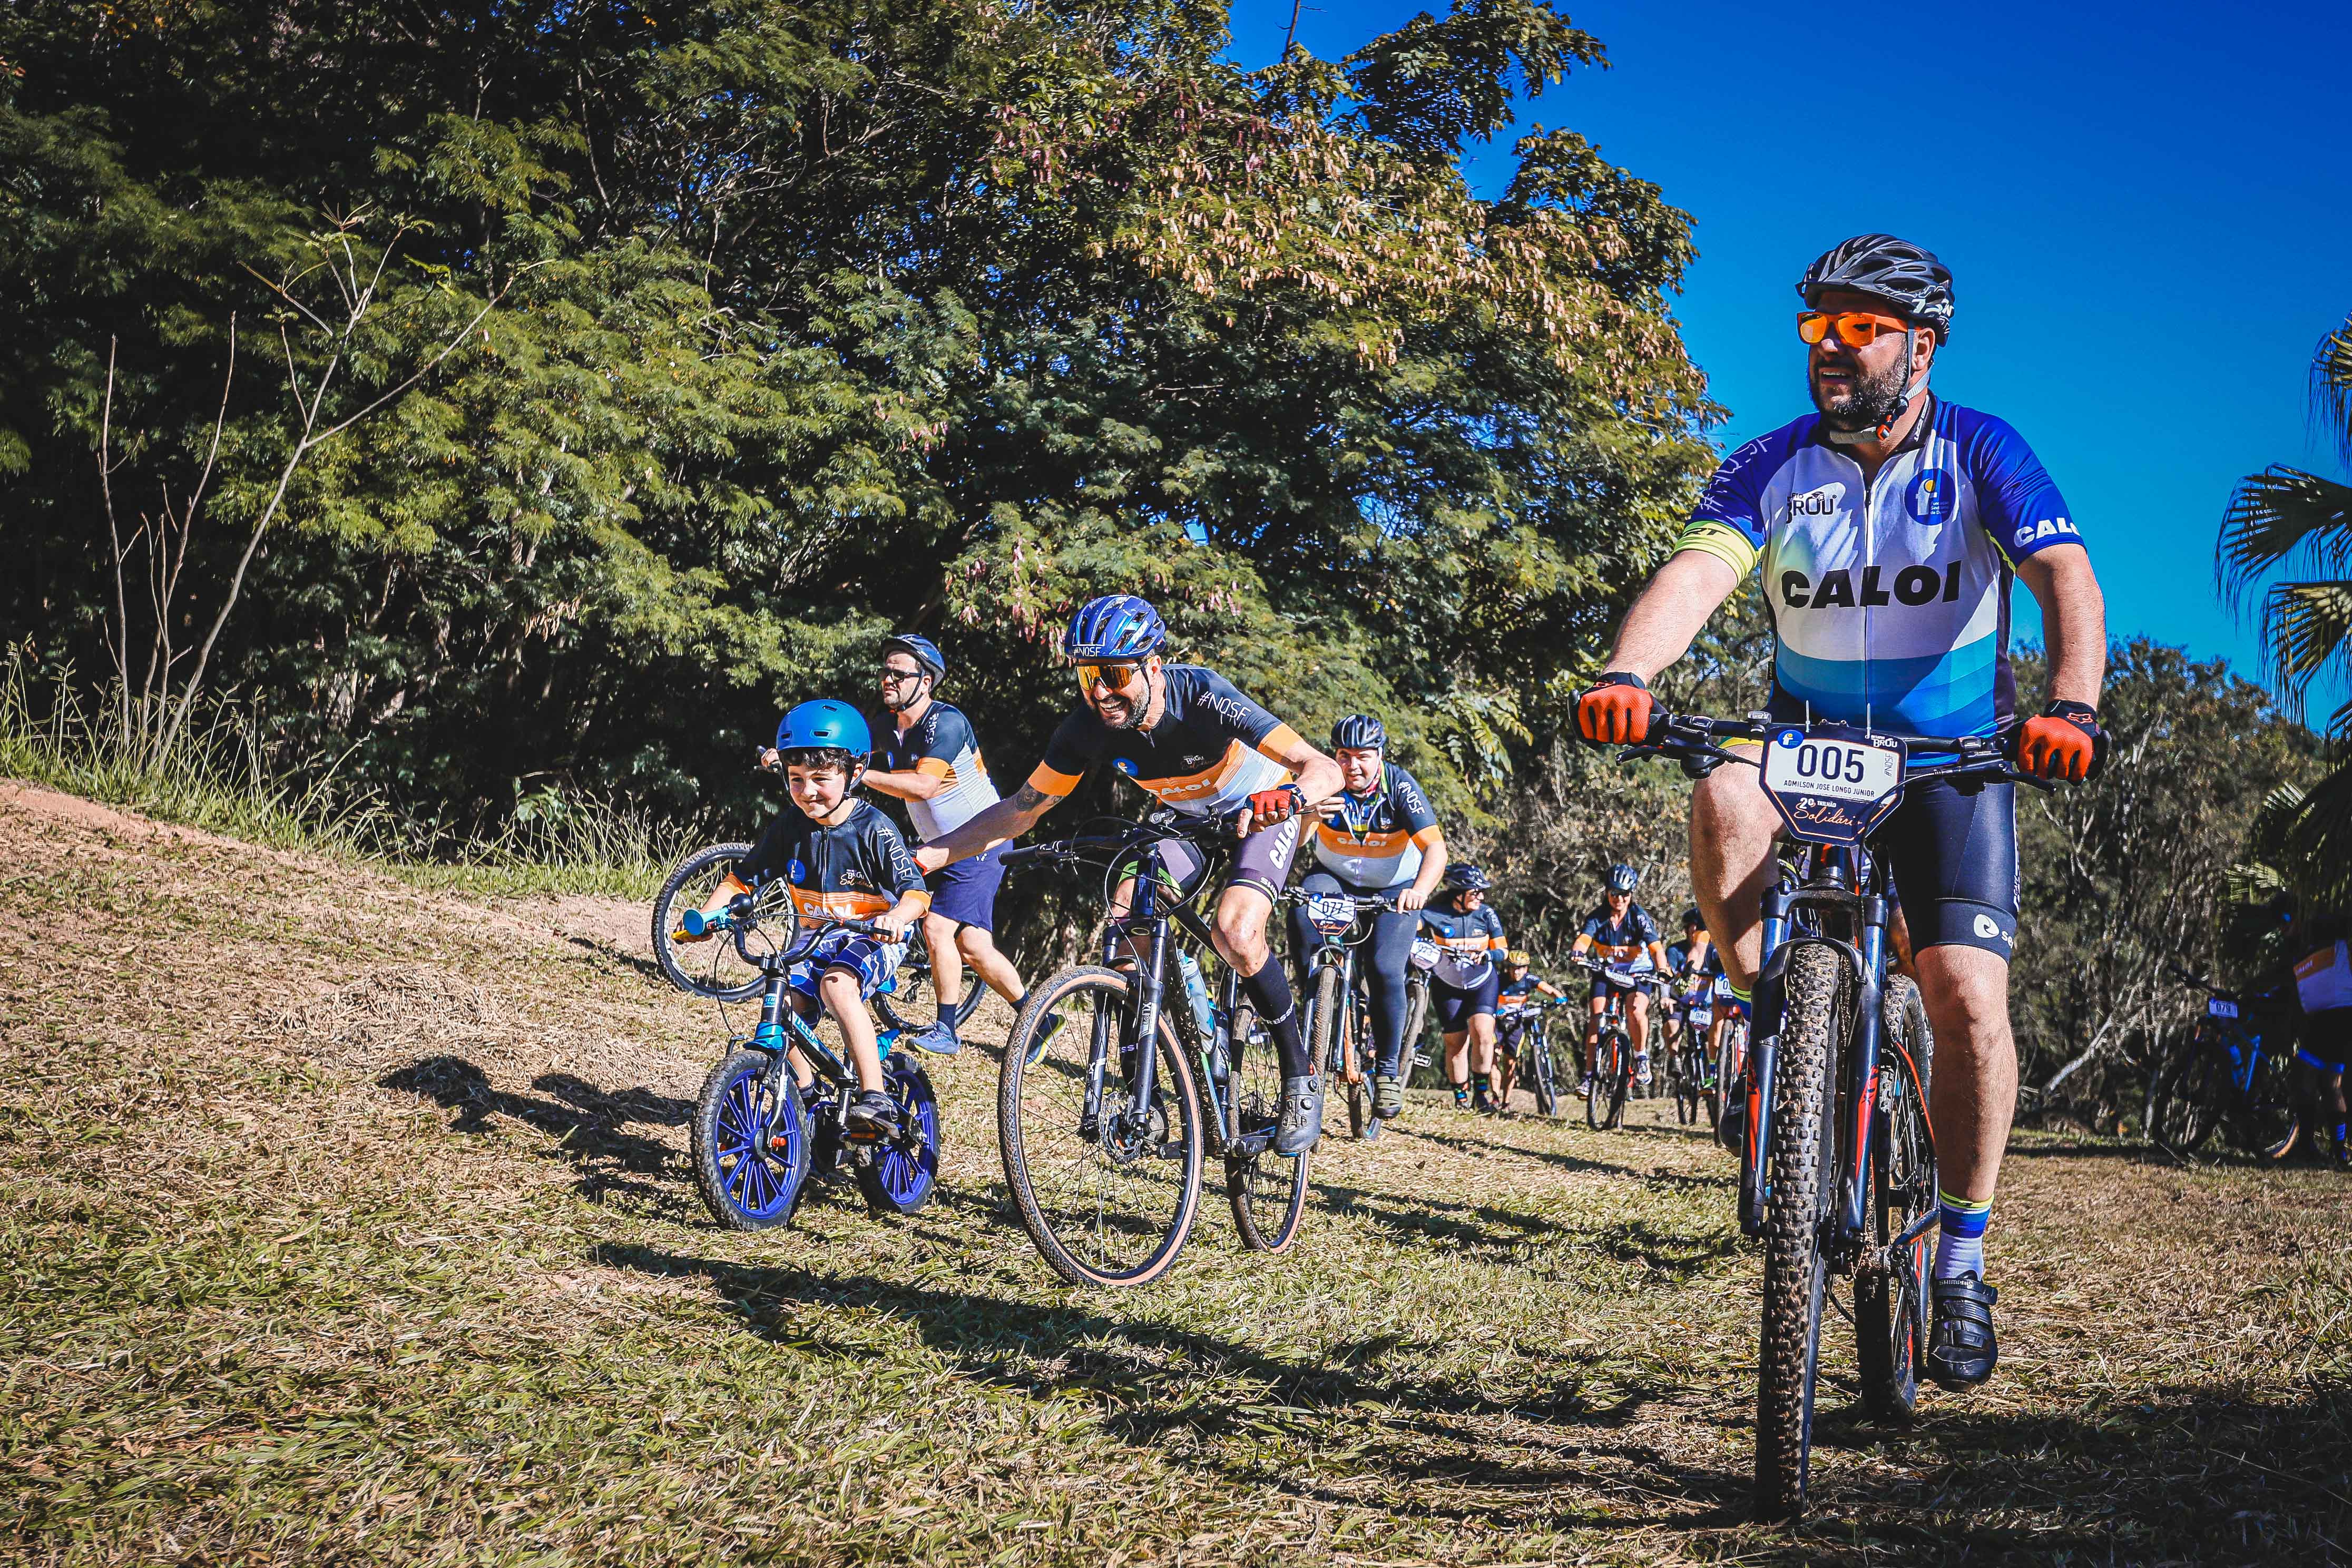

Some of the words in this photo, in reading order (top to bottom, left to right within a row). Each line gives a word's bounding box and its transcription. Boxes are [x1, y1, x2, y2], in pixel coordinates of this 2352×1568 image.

[1781, 560, 1963, 610] CALOI
[1073, 646, 1102, 656] #NOSF
[1197, 691, 1252, 721] #NOSF
[1797, 744, 1864, 783] 005
[1397, 781, 1425, 815] #NOSF
[1783, 780, 1814, 789] ADMILSON
[1832, 786, 1851, 794] LONGO
[1794, 803, 1863, 826] Solidári
[877, 827, 913, 876] #NOSF
[1269, 817, 1299, 870] CALOI
[1322, 901, 1344, 916] 077
